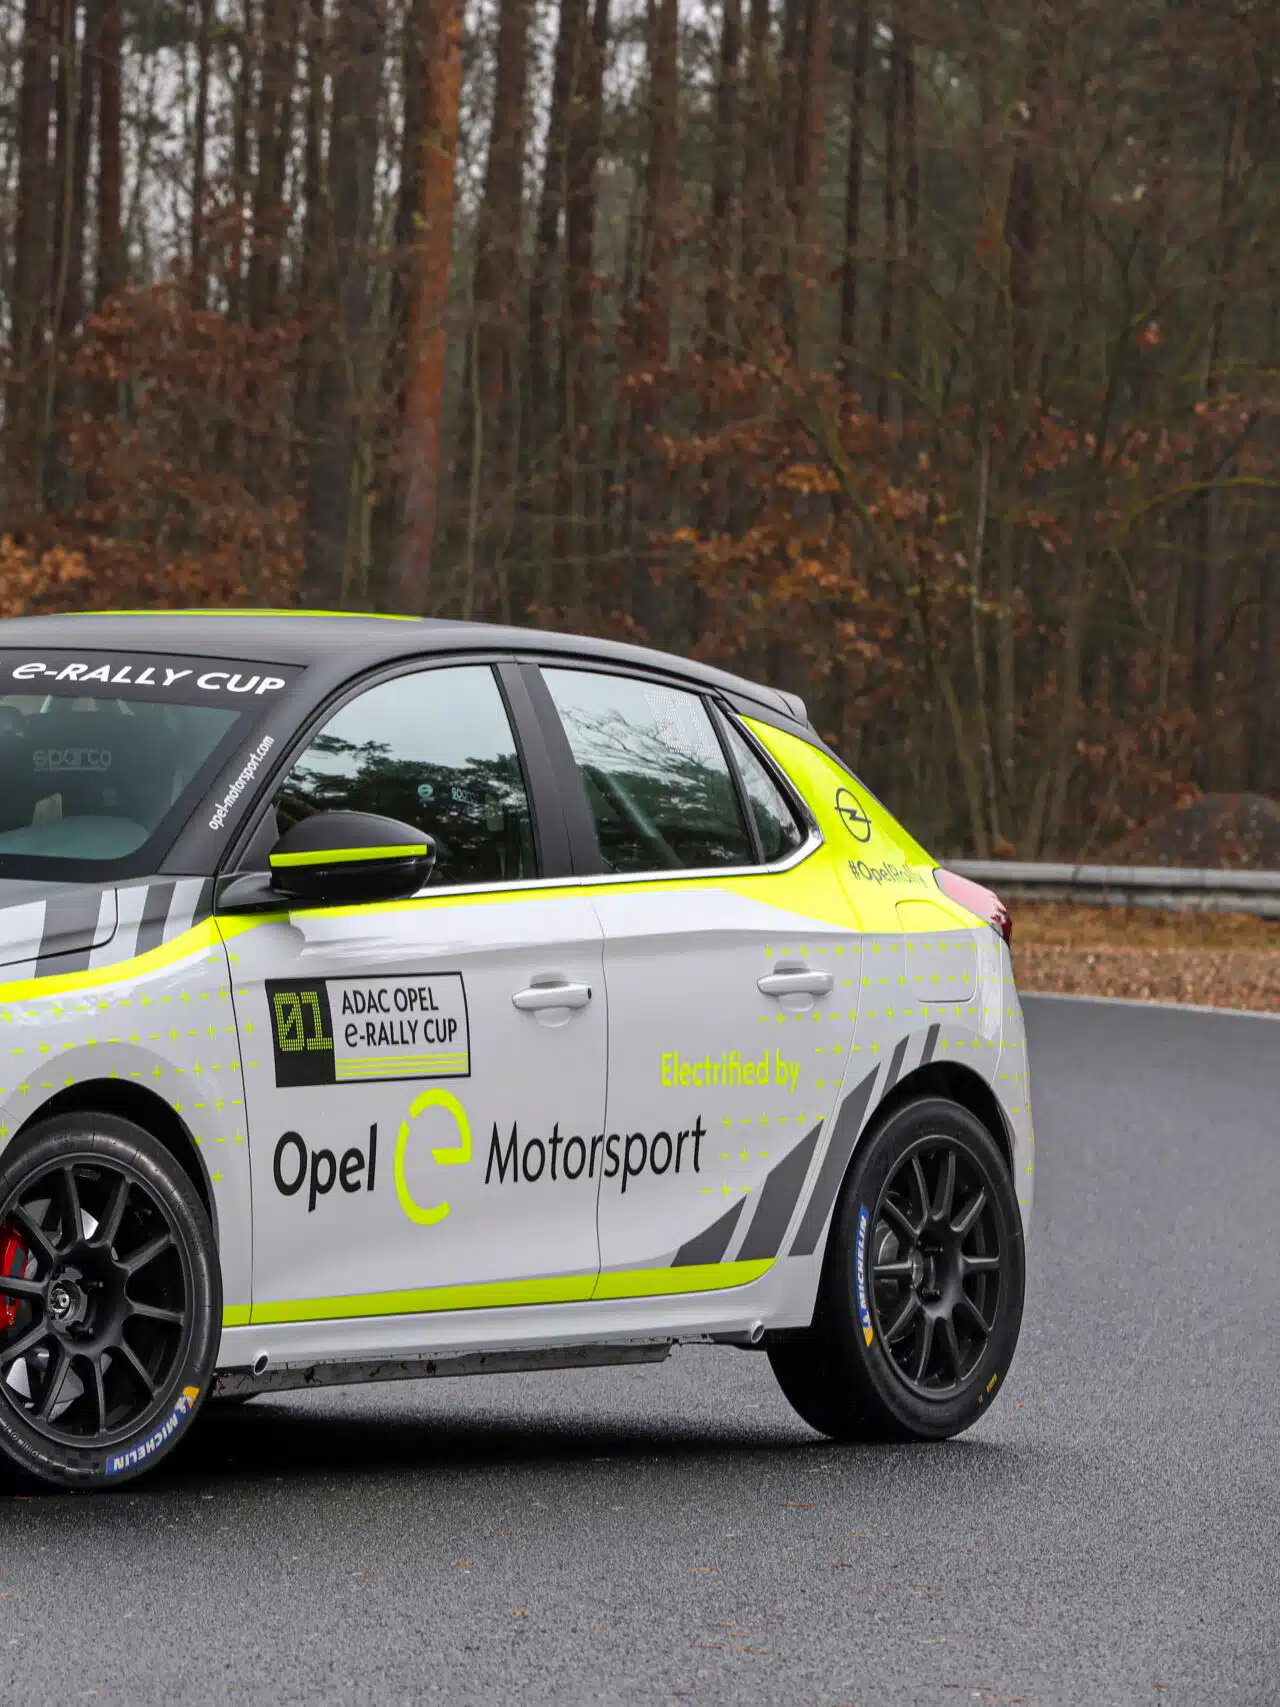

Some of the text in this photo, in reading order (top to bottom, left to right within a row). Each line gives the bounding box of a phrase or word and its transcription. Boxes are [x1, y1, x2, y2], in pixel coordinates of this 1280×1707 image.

[12, 662, 193, 687] e-RALLY
[196, 672, 286, 695] CUP
[209, 735, 275, 830] opel-motorsport.com
[274, 991, 334, 1052] 01
[342, 987, 439, 1015] ADAC OPEL
[345, 1018, 457, 1047] e-RALLY CUP
[661, 1048, 800, 1093] Electrified by
[273, 1122, 377, 1213] Opel
[485, 1114, 707, 1195] Motorsport
[857, 1215, 867, 1310] MICHELIN
[113, 1412, 179, 1472] MICHELIN
